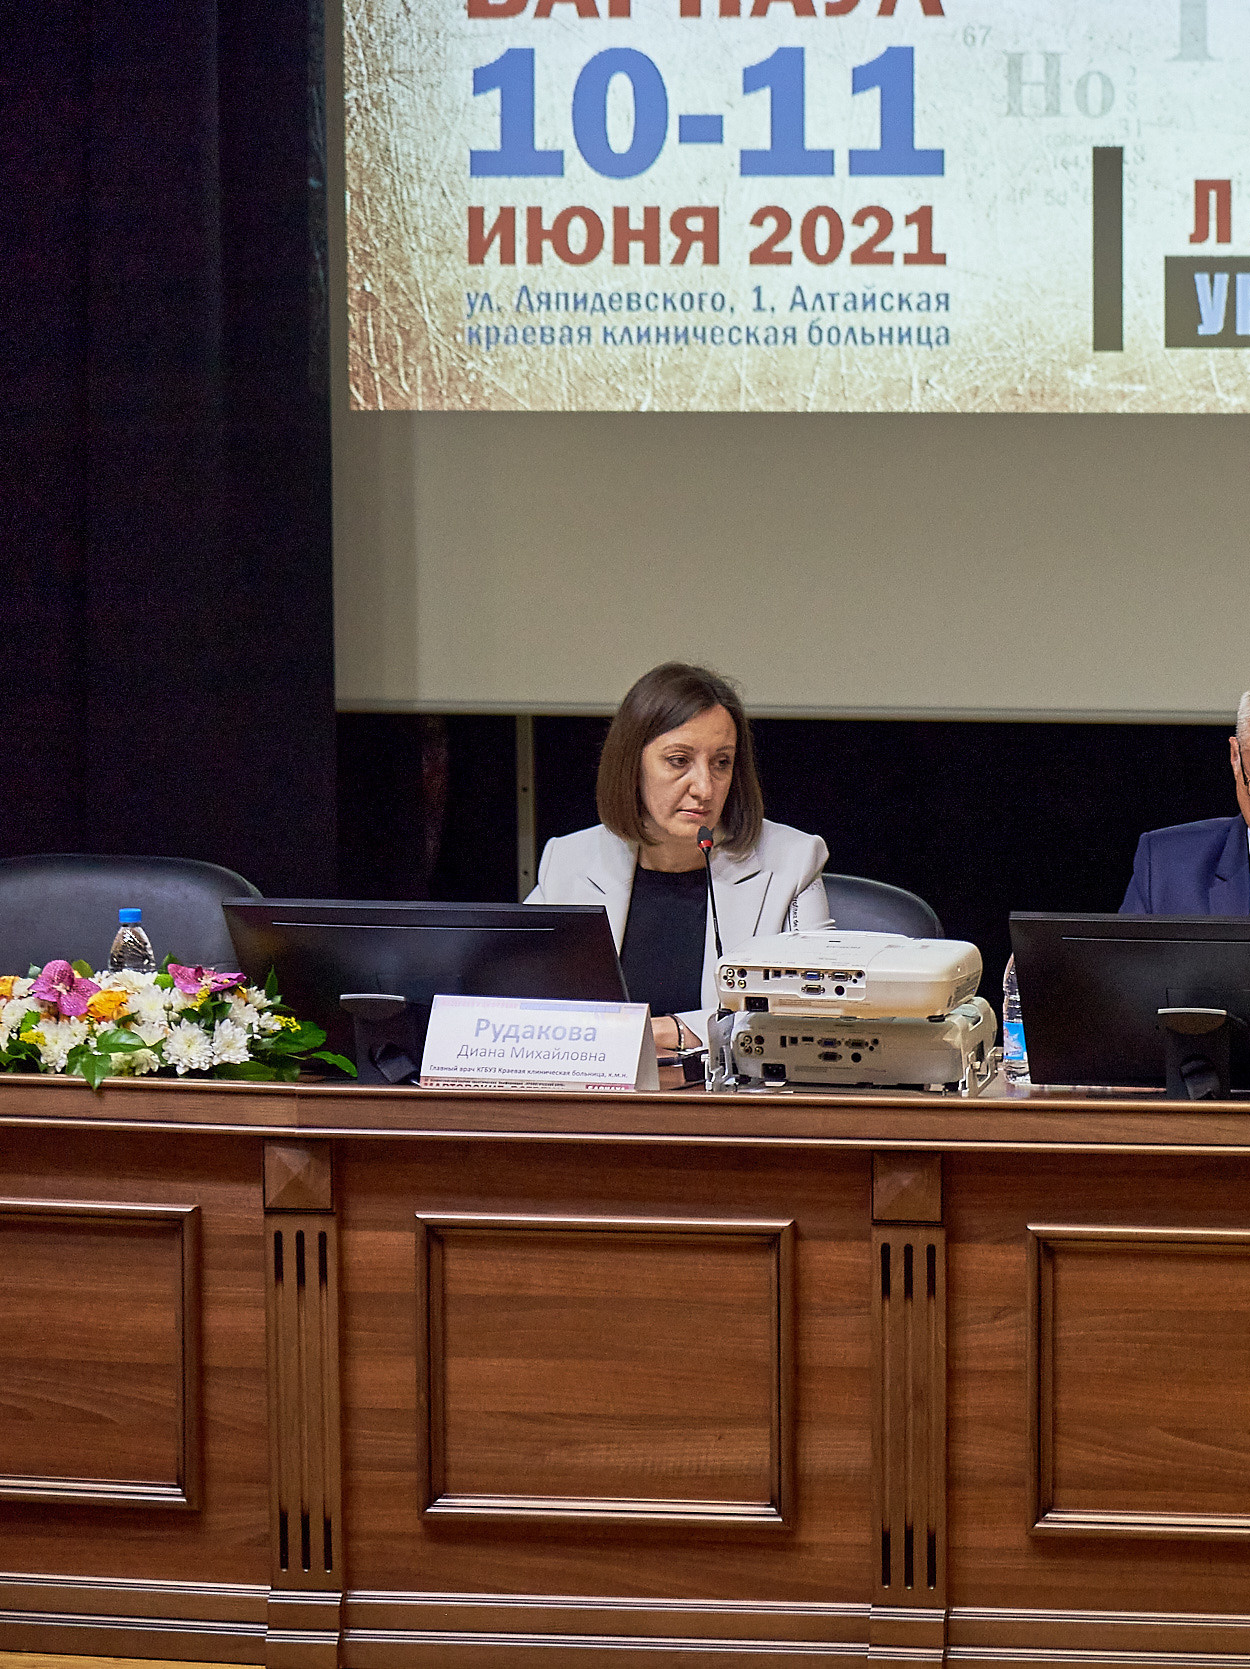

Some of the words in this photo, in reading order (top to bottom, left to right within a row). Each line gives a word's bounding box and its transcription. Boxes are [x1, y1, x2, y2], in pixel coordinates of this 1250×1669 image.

[470, 46, 944, 179] 10-11
[467, 206, 718, 266] ИЮНЯ
[749, 206, 946, 266] 2021
[466, 291, 501, 317] ул.
[515, 285, 735, 316] Ляпидевского,
[752, 285, 775, 318] 1,
[790, 284, 951, 313] Алтайская
[466, 322, 592, 348] краевая
[603, 322, 796, 347] клиническая
[808, 317, 951, 349] больница
[473, 1018, 598, 1044] Рудакова
[457, 1044, 505, 1059] Диана
[510, 1046, 606, 1062] Михайловна
[571, 1070, 607, 1078] больница,
